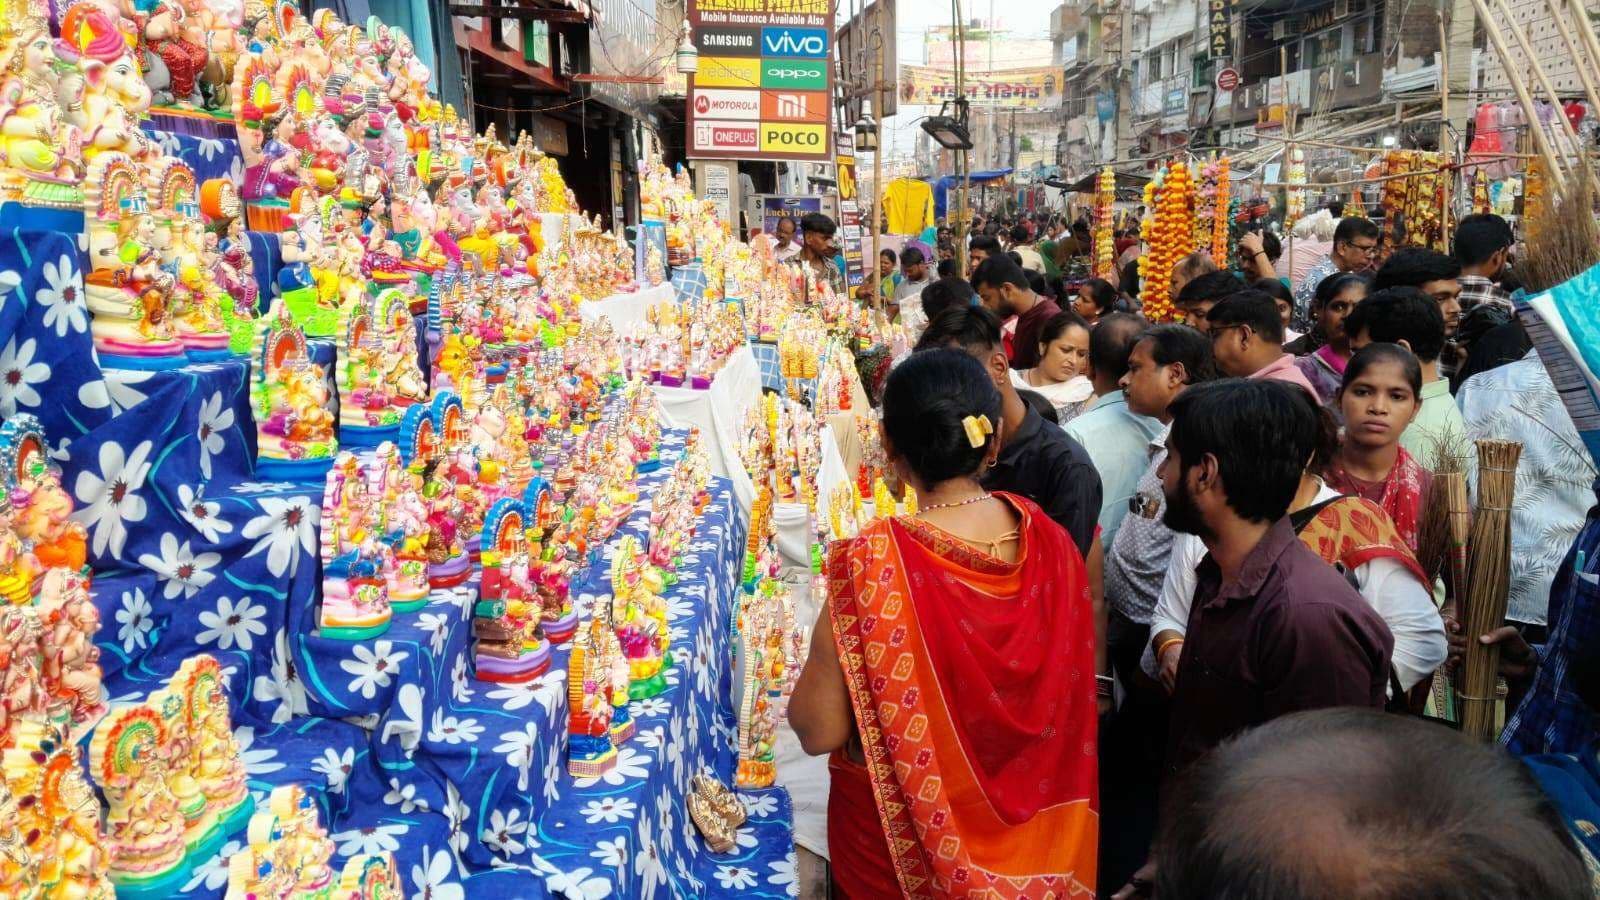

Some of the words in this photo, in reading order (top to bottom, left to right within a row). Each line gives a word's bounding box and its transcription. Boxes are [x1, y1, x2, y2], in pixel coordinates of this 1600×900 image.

[696, 0, 765, 12] SAMSUNG
[767, 0, 828, 14] FINANCE
[701, 11, 727, 22] Mobile
[729, 12, 767, 23] Insurance
[769, 13, 805, 25] Available
[807, 15, 825, 26] Also
[703, 34, 753, 47] SAMSUNG
[711, 100, 758, 110] MOTOROLA
[714, 131, 756, 143] ONEPLUS
[767, 131, 820, 146] POCO
[766, 208, 790, 217] Lucky
